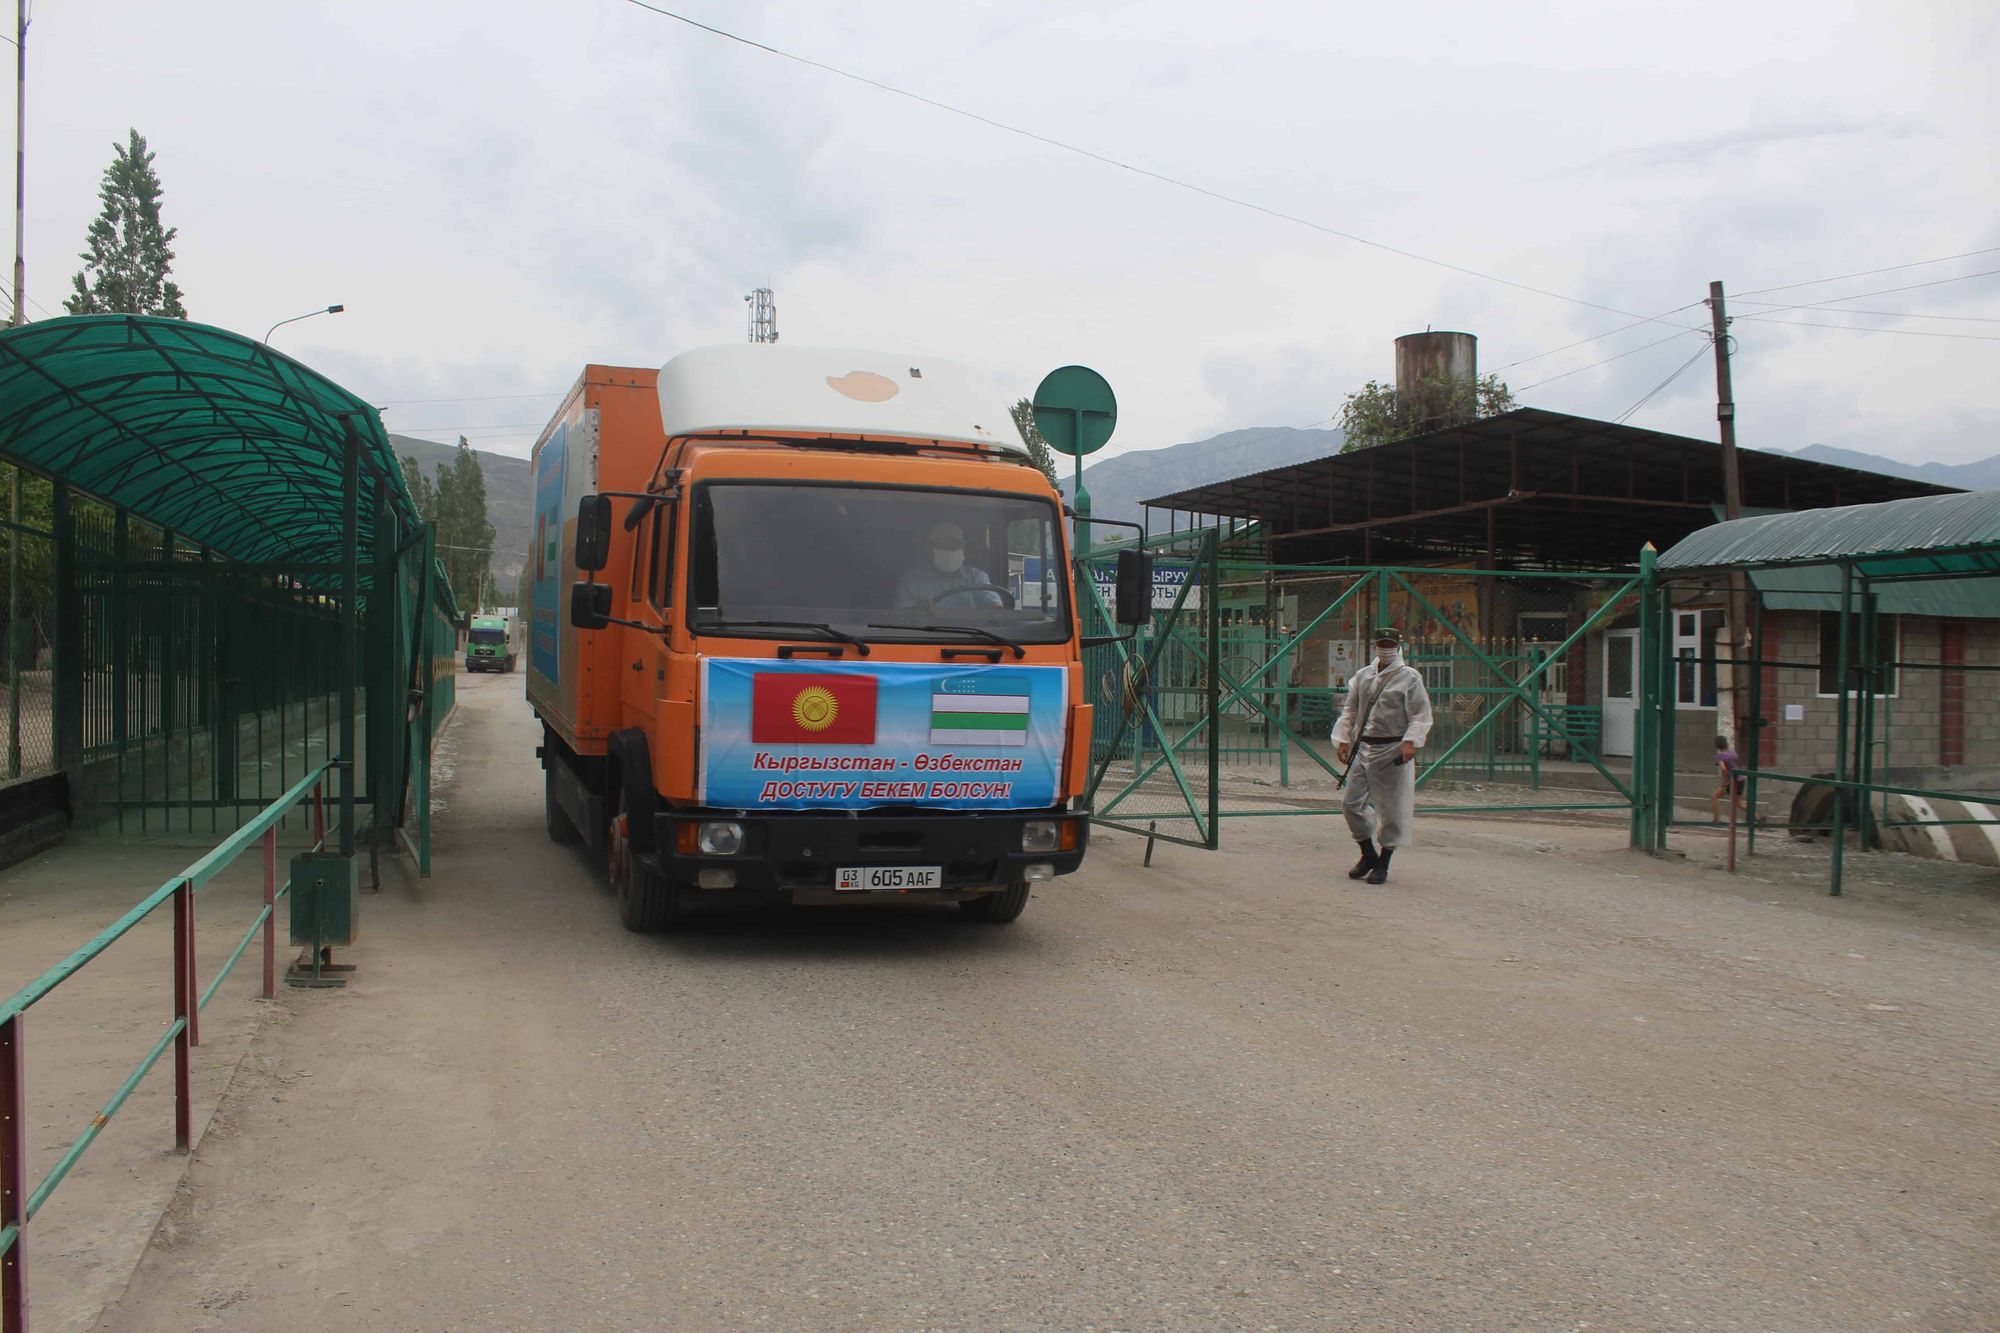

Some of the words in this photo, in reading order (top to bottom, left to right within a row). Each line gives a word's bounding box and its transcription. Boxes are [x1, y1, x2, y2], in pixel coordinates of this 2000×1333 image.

[753, 752, 896, 774] Кыргызстан
[914, 754, 1022, 772] Өзбекстан
[759, 781, 857, 801] ДОСТУГУ
[860, 782, 926, 798] БЕКЕМ
[929, 782, 1012, 799] БОЛСУН!
[842, 870, 858, 881] 03
[871, 869, 903, 887] 605
[906, 872, 935, 886] AAF
